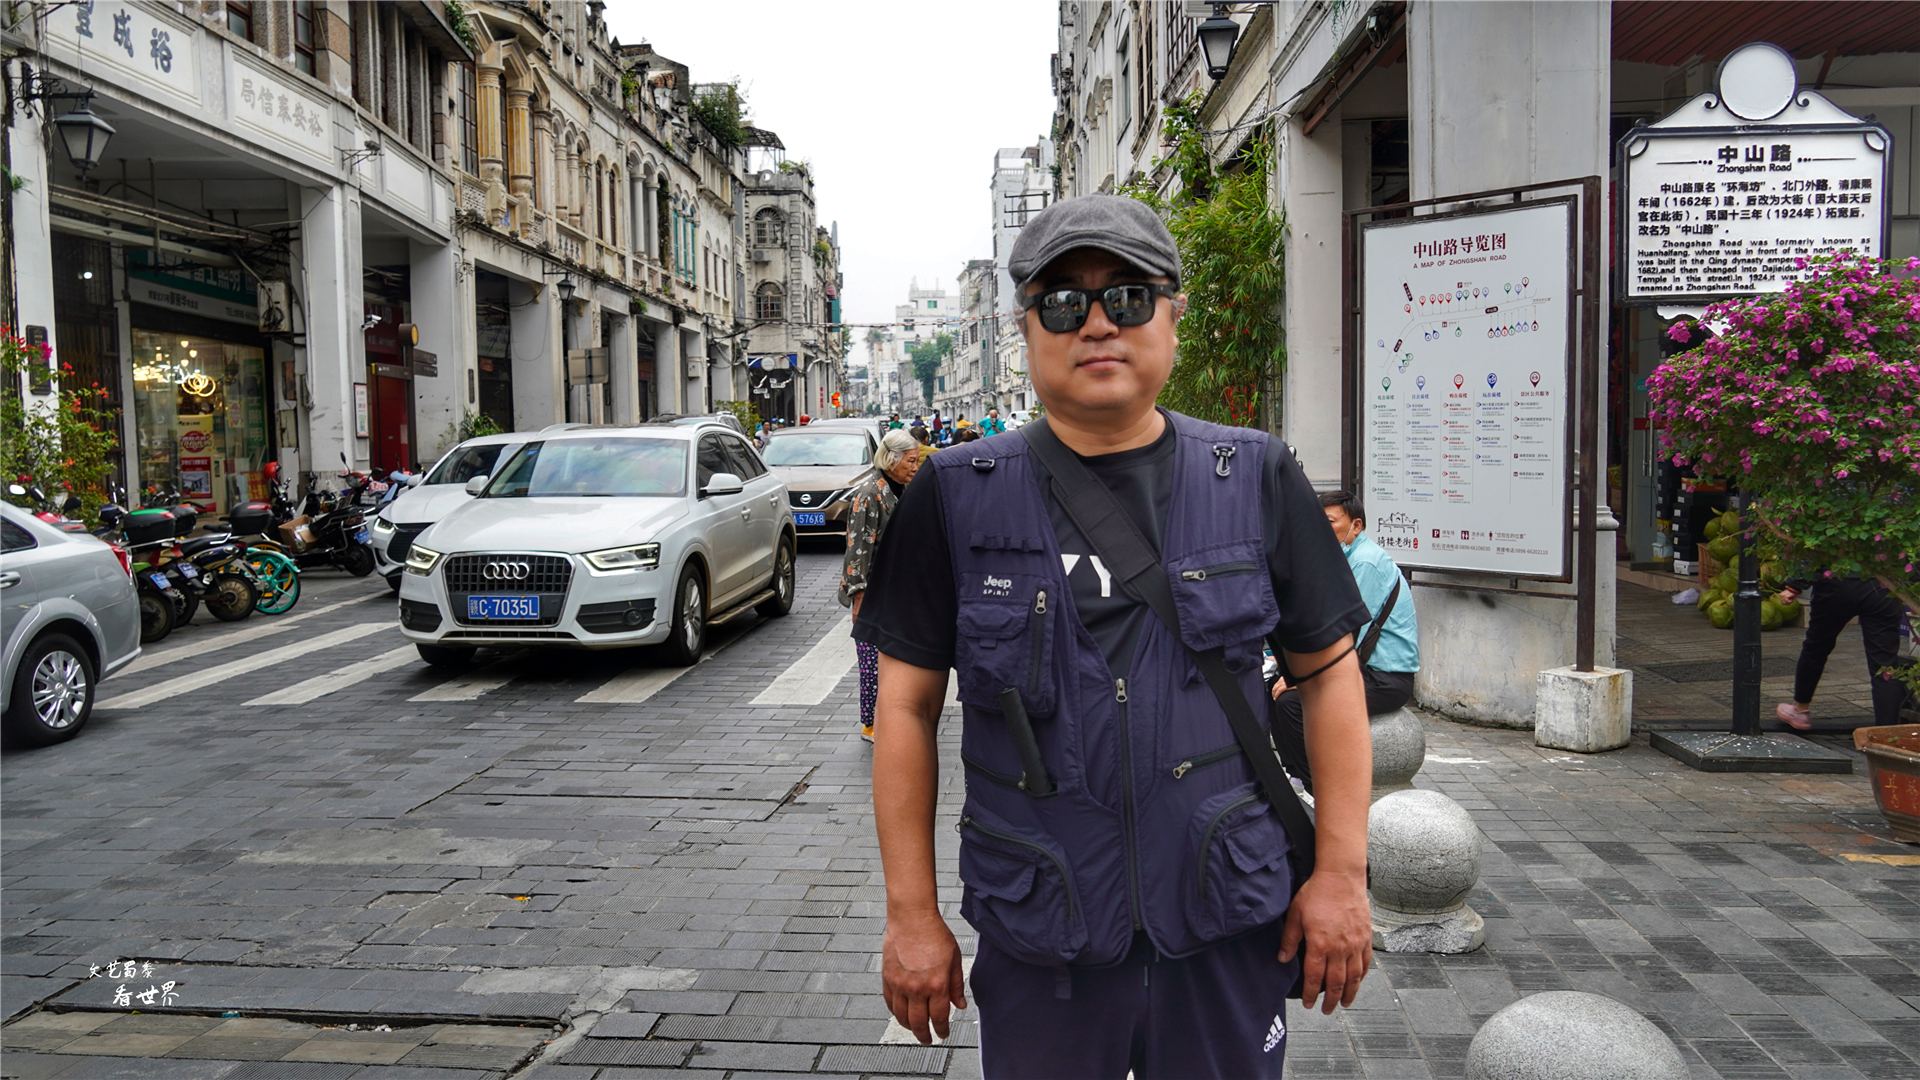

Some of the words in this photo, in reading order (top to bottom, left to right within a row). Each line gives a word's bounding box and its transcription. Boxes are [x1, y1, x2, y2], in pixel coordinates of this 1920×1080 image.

[1717, 144, 1792, 164] 中山路
[1717, 163, 1766, 174] Zhongshan
[1769, 162, 1792, 172] Road
[1413, 232, 1506, 259] 中山路导览图
[1662, 239, 1712, 248] Zhongshan
[1776, 238, 1815, 246] formerly
[1694, 247, 1720, 255] where
[1746, 247, 1753, 255] in
[1758, 246, 1777, 254] front
[1782, 246, 1790, 254] of
[1795, 246, 1808, 254] the
[1813, 246, 1835, 254] north
[1449, 256, 1487, 266] ZHONGSHAN
[1637, 259, 1654, 267] was
[1708, 257, 1728, 265] Qing
[1732, 257, 1763, 265] dynasty
[1680, 266, 1699, 274] then
[1703, 266, 1737, 275] changed
[1637, 275, 1667, 284] Temple
[1673, 275, 1680, 283] in
[1686, 275, 1701, 283] this
[1637, 284, 1672, 292] renamed
[1686, 283, 1731, 292] Zhongshan
[983, 575, 1012, 589] Jeep
